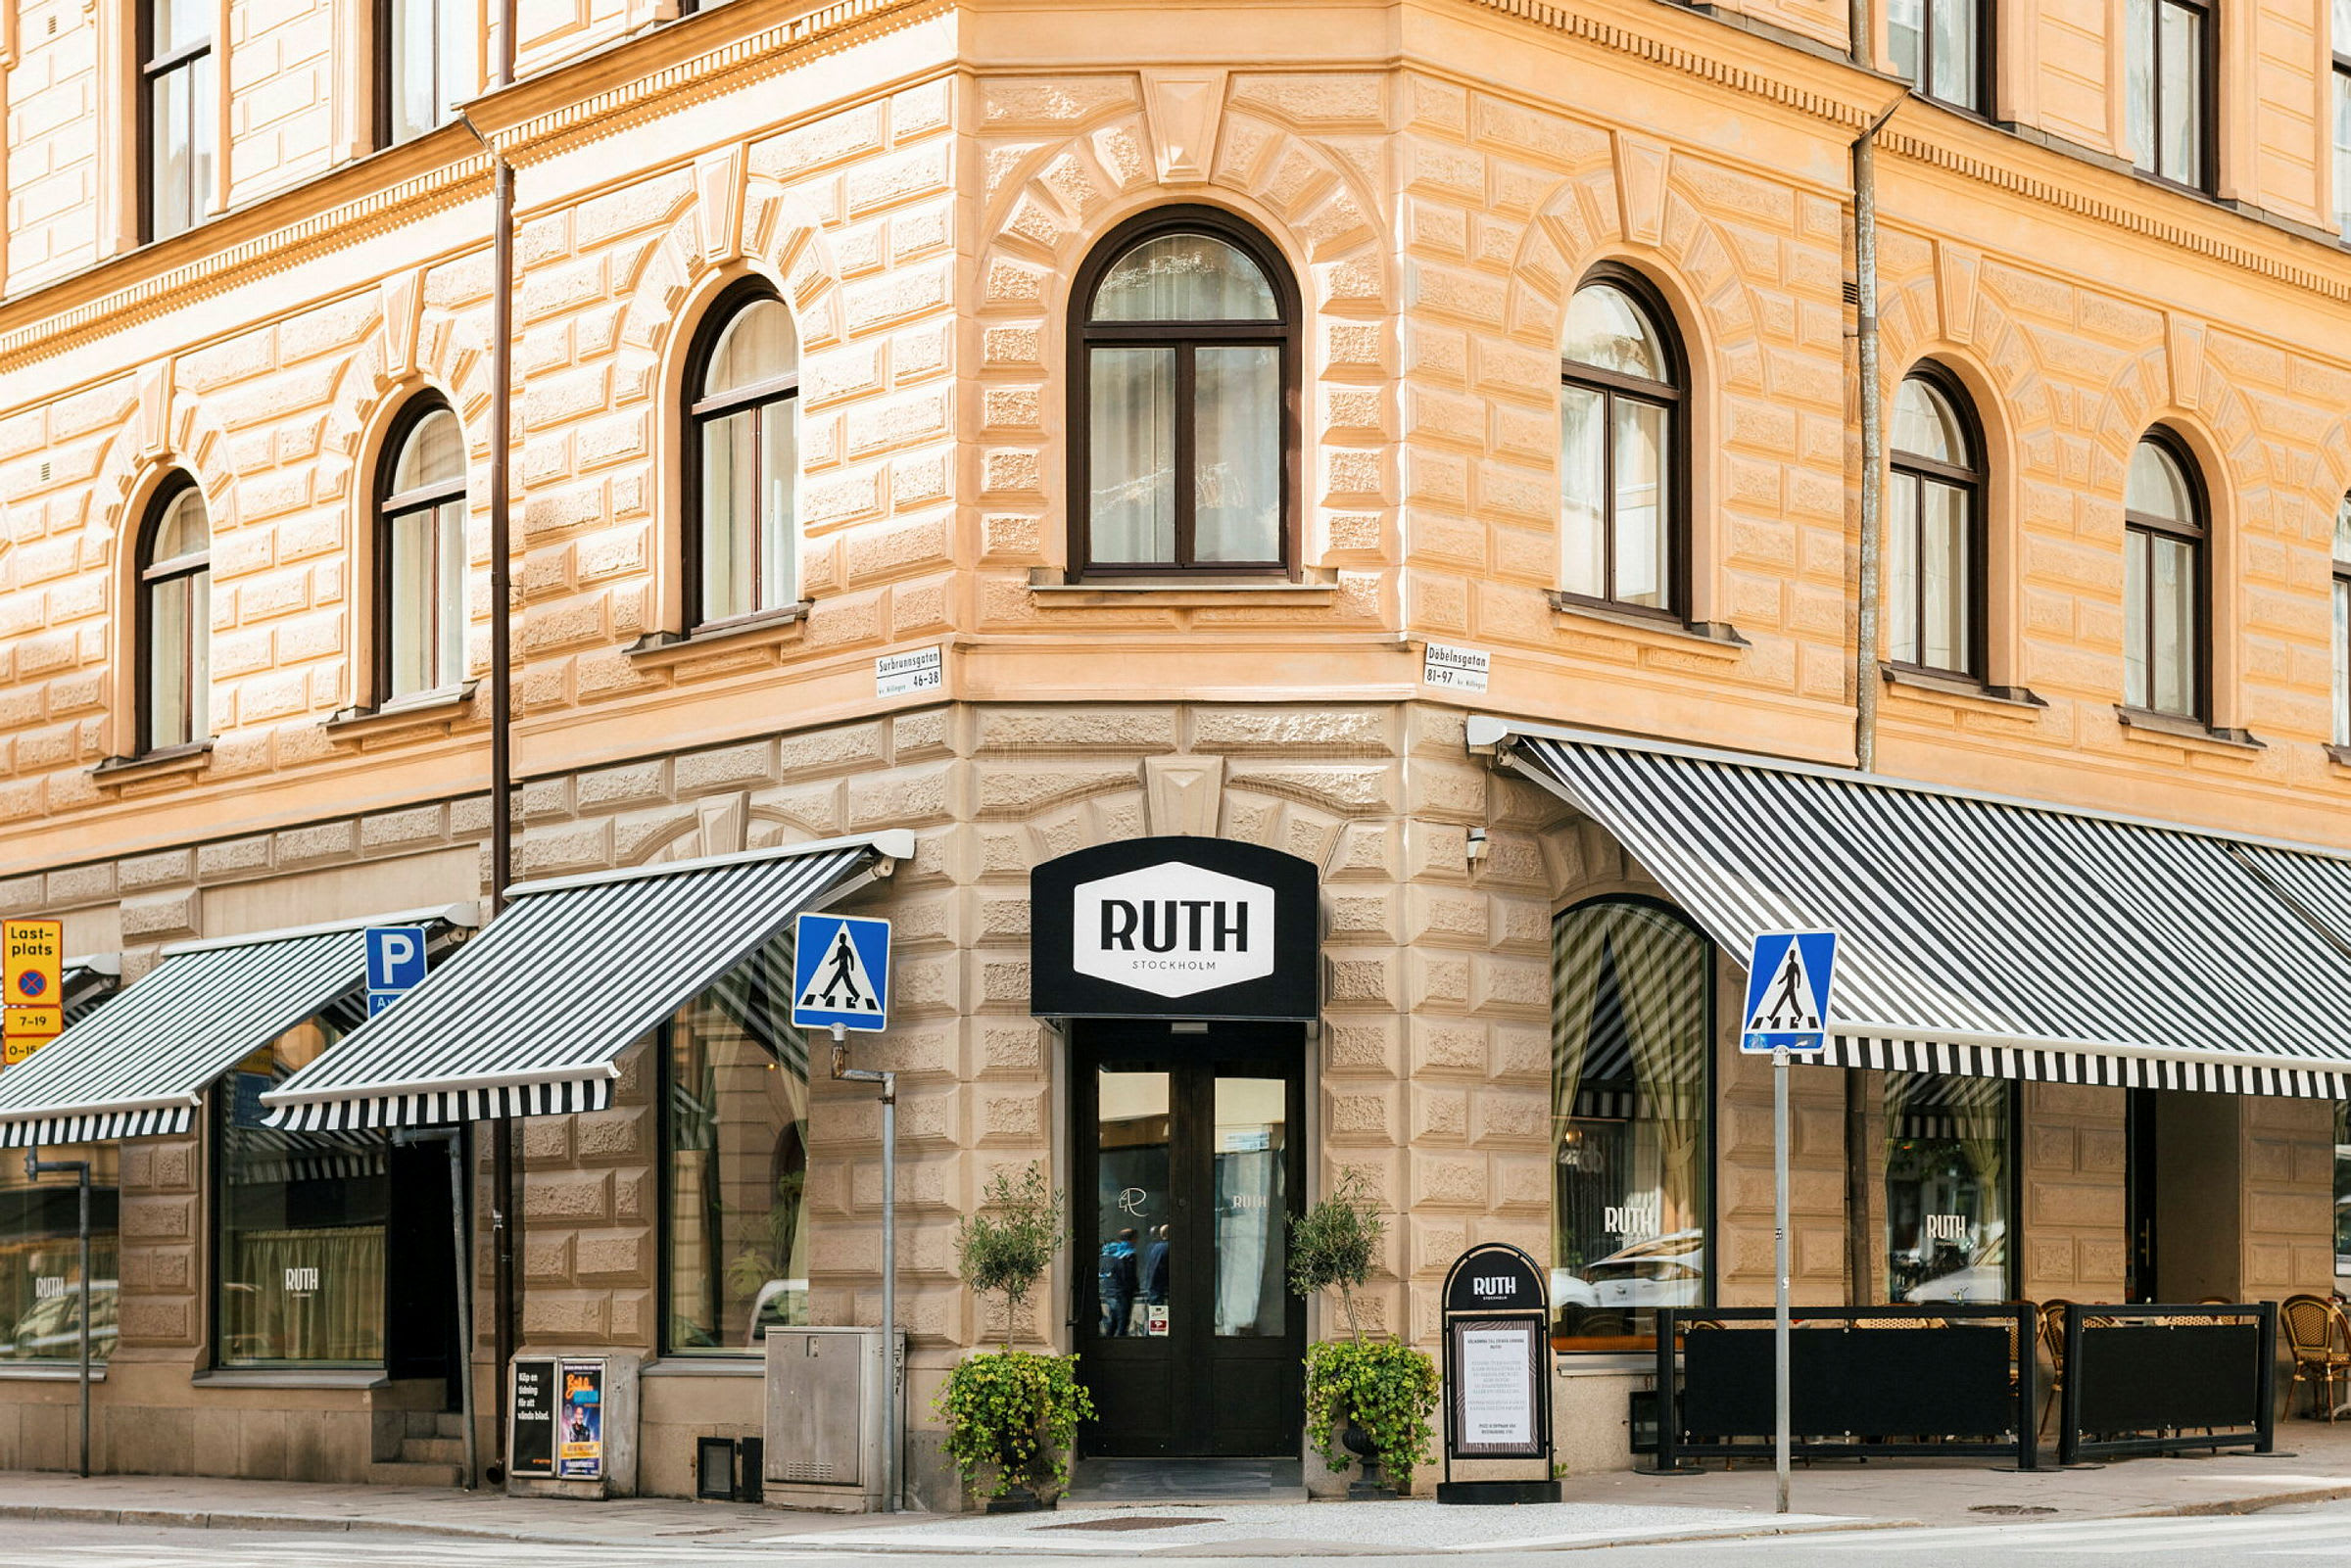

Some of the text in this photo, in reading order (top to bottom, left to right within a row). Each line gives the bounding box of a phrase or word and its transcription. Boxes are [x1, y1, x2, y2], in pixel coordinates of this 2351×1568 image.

[879, 651, 938, 673] Surbrunnsgatan
[1428, 646, 1486, 668] Döbelnsgatan
[913, 671, 939, 687] 46-38
[1426, 669, 1454, 684] 81-97
[11, 927, 54, 939] Last-
[1100, 899, 1248, 953] RUTH
[12, 943, 53, 958] plats
[381, 933, 414, 984] P
[1132, 960, 1217, 971] STOCKHOLM
[20, 1016, 47, 1026] 7-19
[1604, 1207, 1654, 1233] RUTH
[1926, 1214, 1966, 1239] RUTH
[35, 1276, 64, 1299] RUTH
[285, 1267, 318, 1291] RUTH
[1472, 1276, 1516, 1296] RUTH
